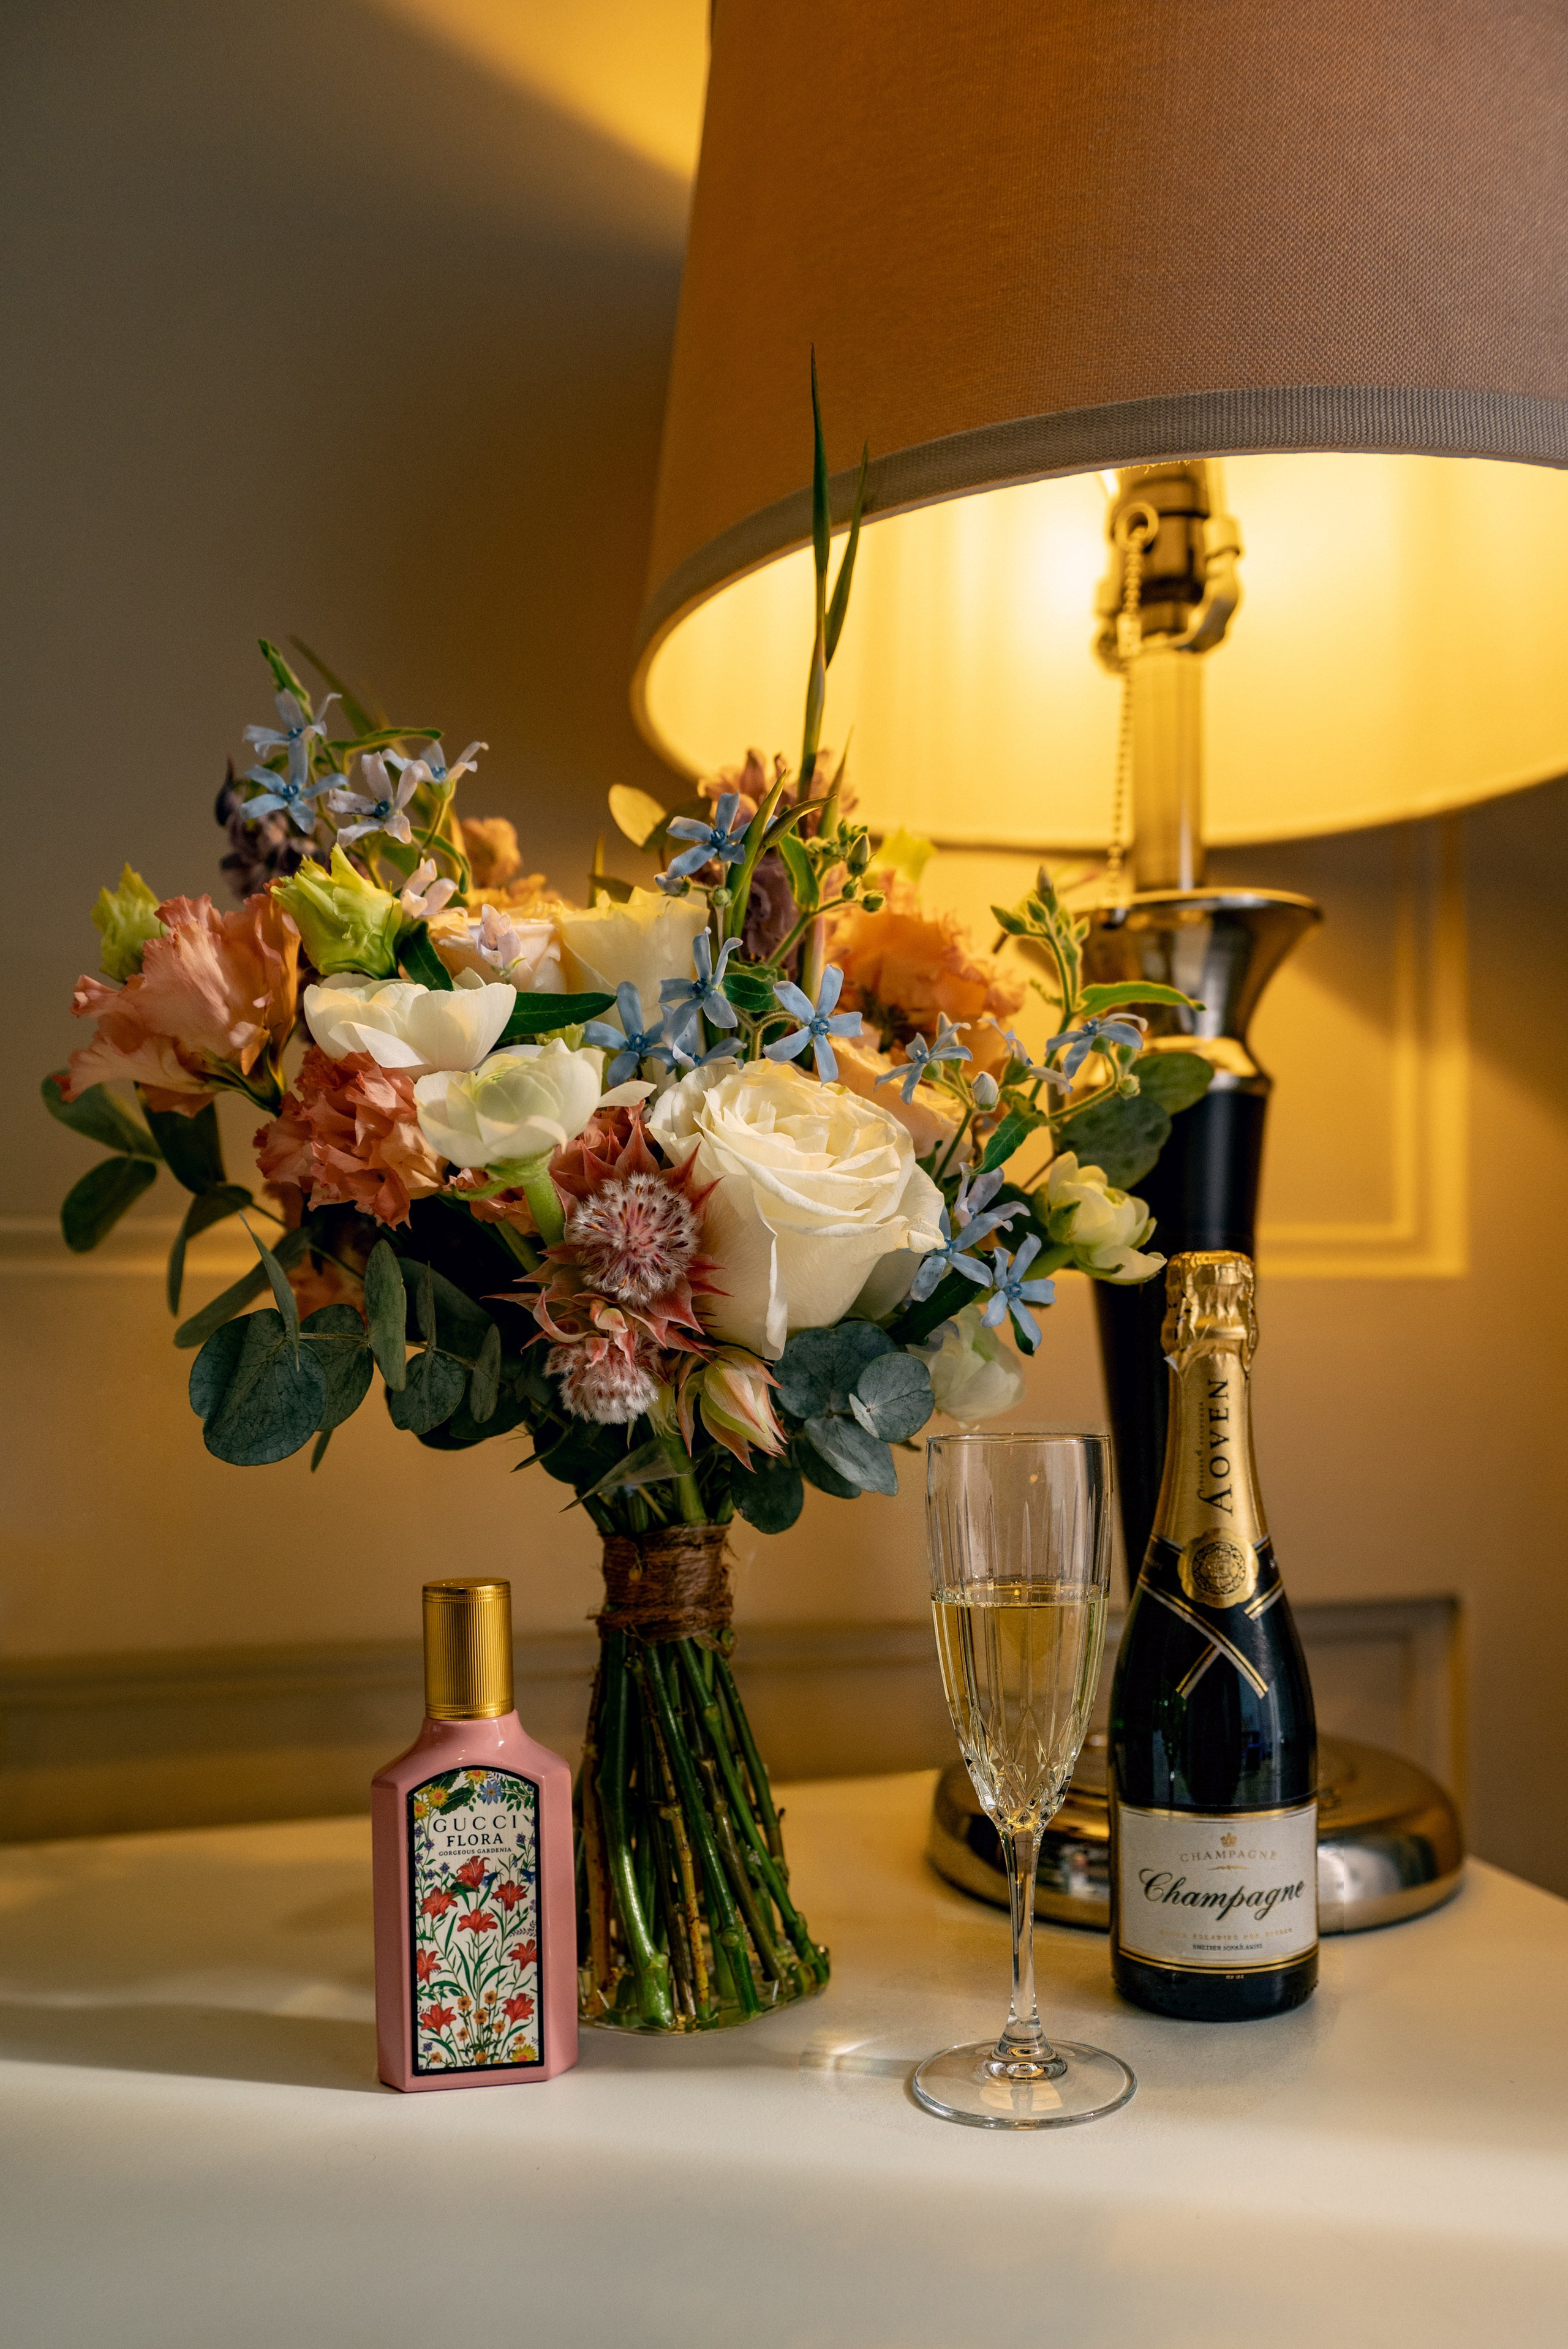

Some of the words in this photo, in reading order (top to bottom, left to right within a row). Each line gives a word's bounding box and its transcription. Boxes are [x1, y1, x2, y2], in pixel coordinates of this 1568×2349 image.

[1197, 1379, 1234, 1517] AOVEN
[433, 1815, 517, 1833] GUCCI
[447, 1833, 503, 1847] FLORA
[1180, 1850, 1278, 1863] CHAMPAGNE
[1139, 1868, 1305, 1921] Champagne
